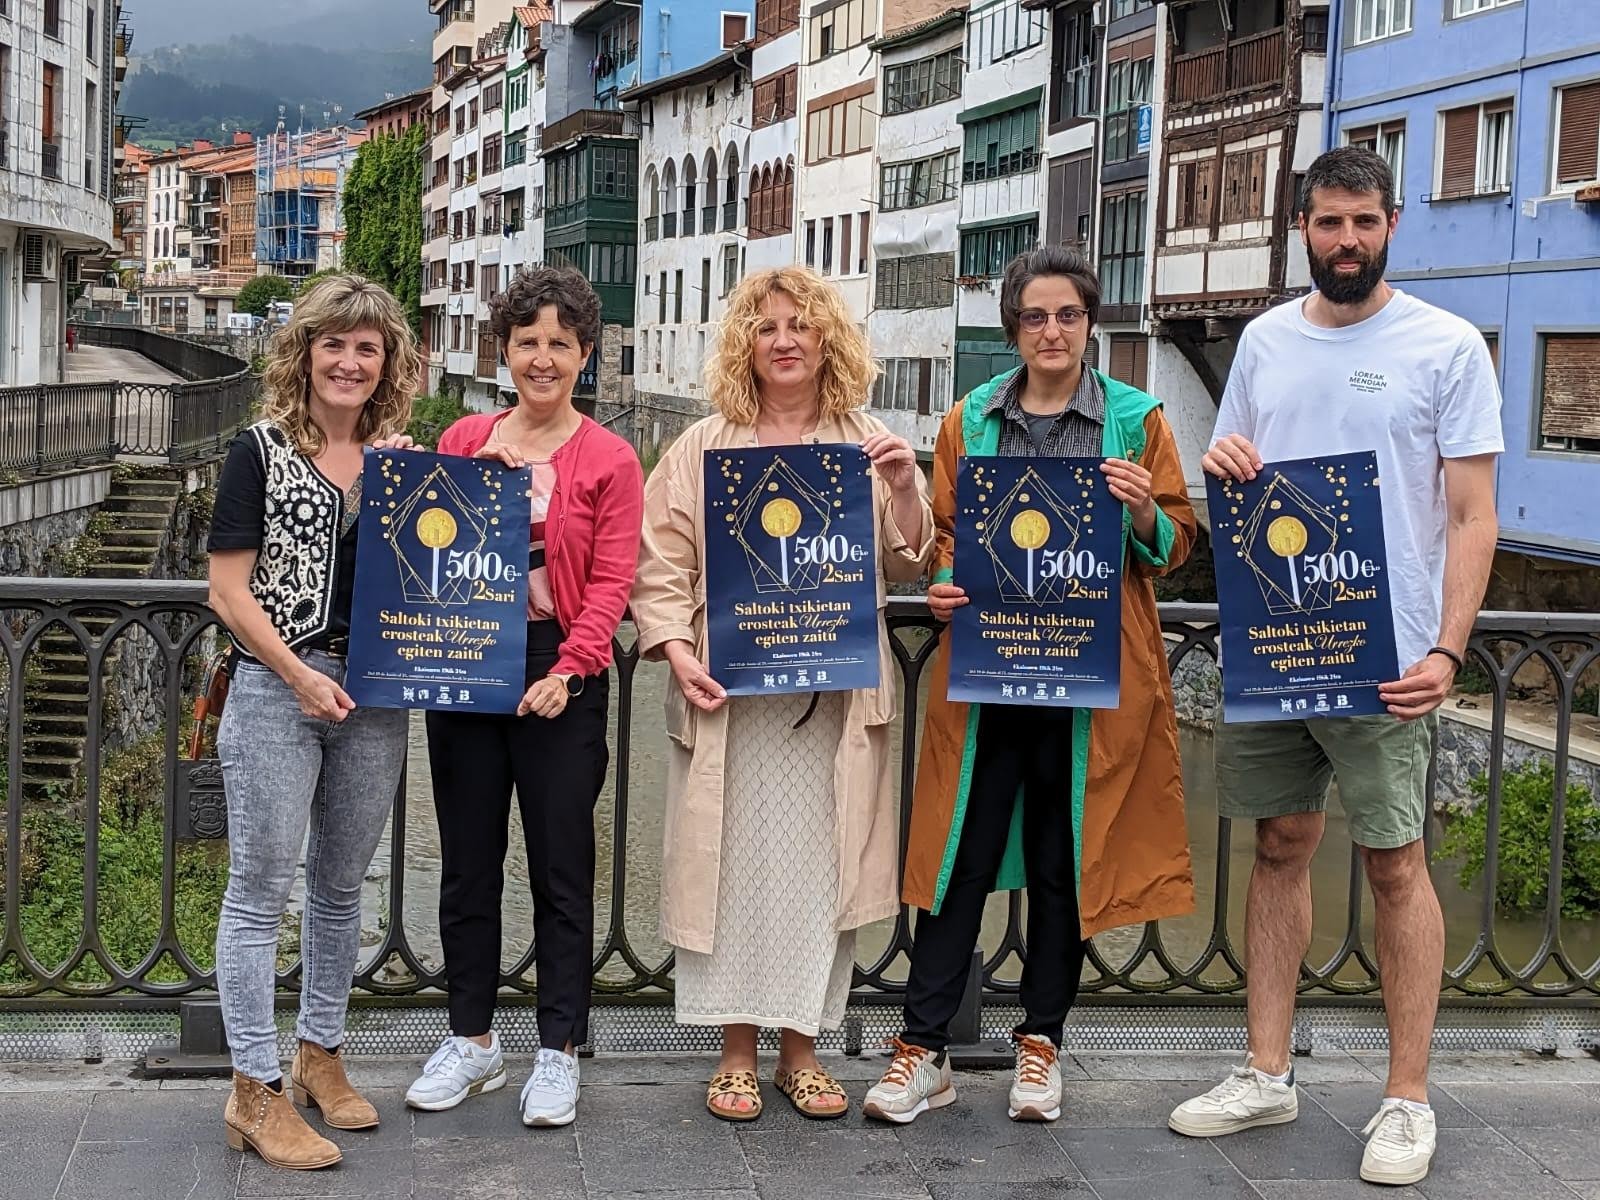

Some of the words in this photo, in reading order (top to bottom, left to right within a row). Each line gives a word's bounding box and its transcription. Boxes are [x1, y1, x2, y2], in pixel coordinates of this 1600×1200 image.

[1349, 376, 1387, 388] MENDIAN
[1354, 370, 1385, 380] LOREAK
[734, 601, 784, 616] Saltoki
[790, 599, 851, 614] txikietan
[379, 610, 431, 627] Saltoki
[435, 614, 500, 631] txikietan
[738, 616, 798, 631] erosteak
[799, 614, 849, 632] Urrezko
[979, 611, 1029, 626] Saltoki
[1033, 613, 1095, 628] txikietan
[755, 632, 799, 649] egiten
[802, 629, 837, 643] zaitu
[982, 628, 1041, 641] erosteak
[1042, 626, 1092, 648] Urrezko
[1248, 622, 1300, 640] Saltoki
[1303, 619, 1367, 635] txikietan
[382, 629, 444, 643] erosteak
[444, 629, 497, 650] Urrezko
[1253, 638, 1314, 655] erosteak
[1314, 634, 1366, 653] Urrezko
[397, 644, 443, 660] egiten
[447, 646, 483, 660] zaitu
[997, 642, 1040, 658] egiten
[1044, 644, 1079, 657] zaitu
[1270, 655, 1315, 673] egiten
[1320, 652, 1355, 665] zaitu
